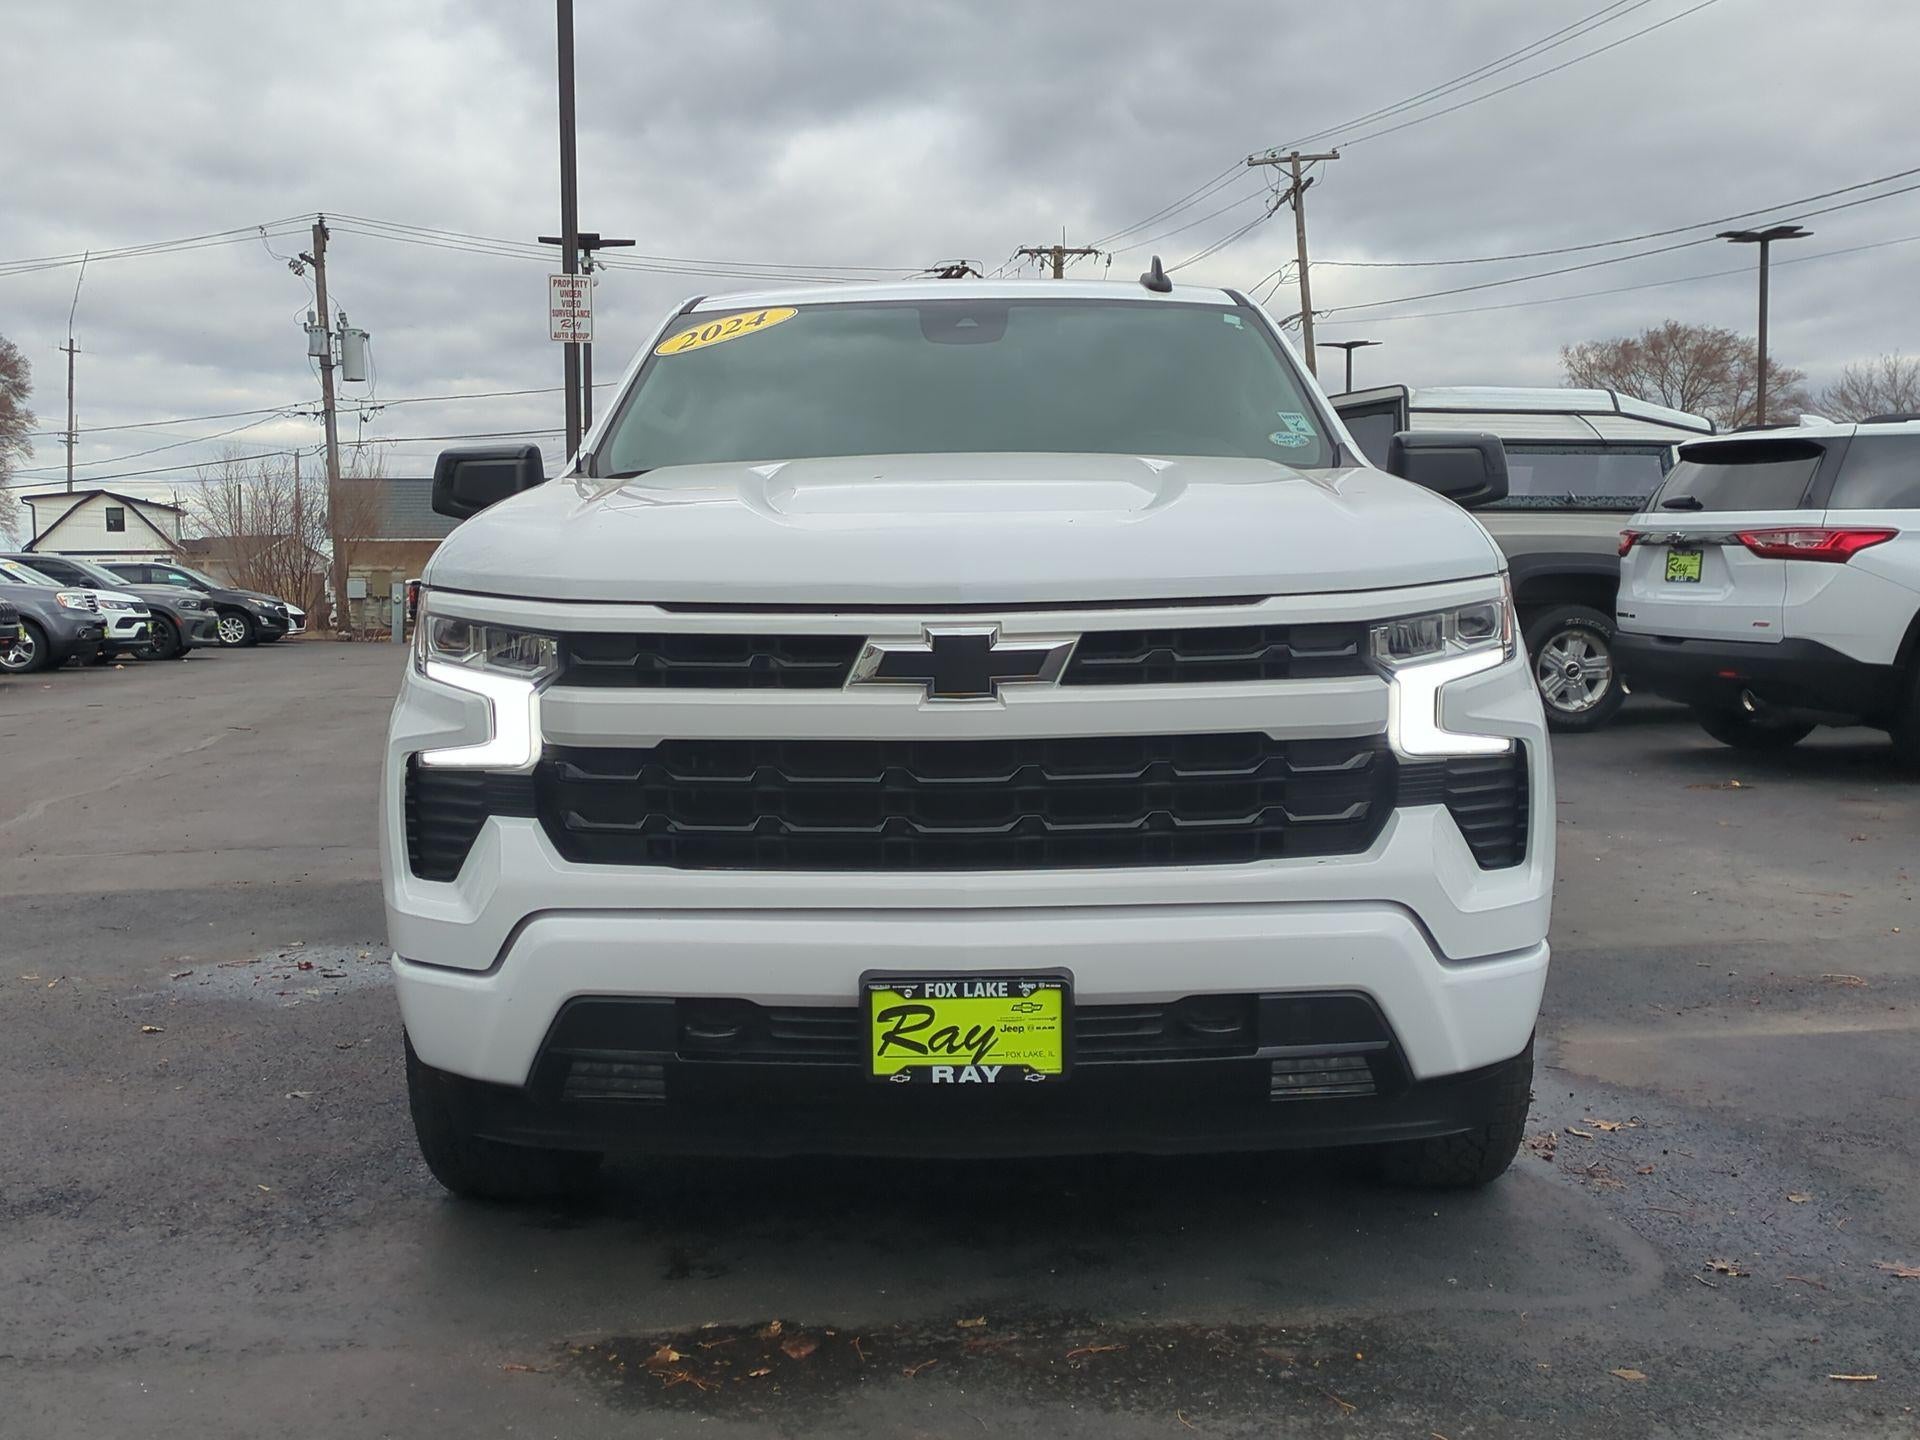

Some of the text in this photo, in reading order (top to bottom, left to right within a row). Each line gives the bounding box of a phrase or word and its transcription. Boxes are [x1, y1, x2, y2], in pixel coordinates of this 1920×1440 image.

[553, 279, 588, 289] PROPRTY
[560, 289, 582, 298] UNDER
[561, 299, 581, 308] VIDEO
[560, 319, 581, 330] Ry
[554, 331, 569, 339] AUTO
[677, 311, 769, 351] 2024
[1669, 557, 1688, 576] Ray
[925, 982, 1008, 998] FOX LAKE
[1018, 982, 1037, 990] Jeep
[1000, 1024, 1025, 1034] Jeep
[877, 1004, 999, 1065] Ray
[932, 1065, 1003, 1084] RAY
